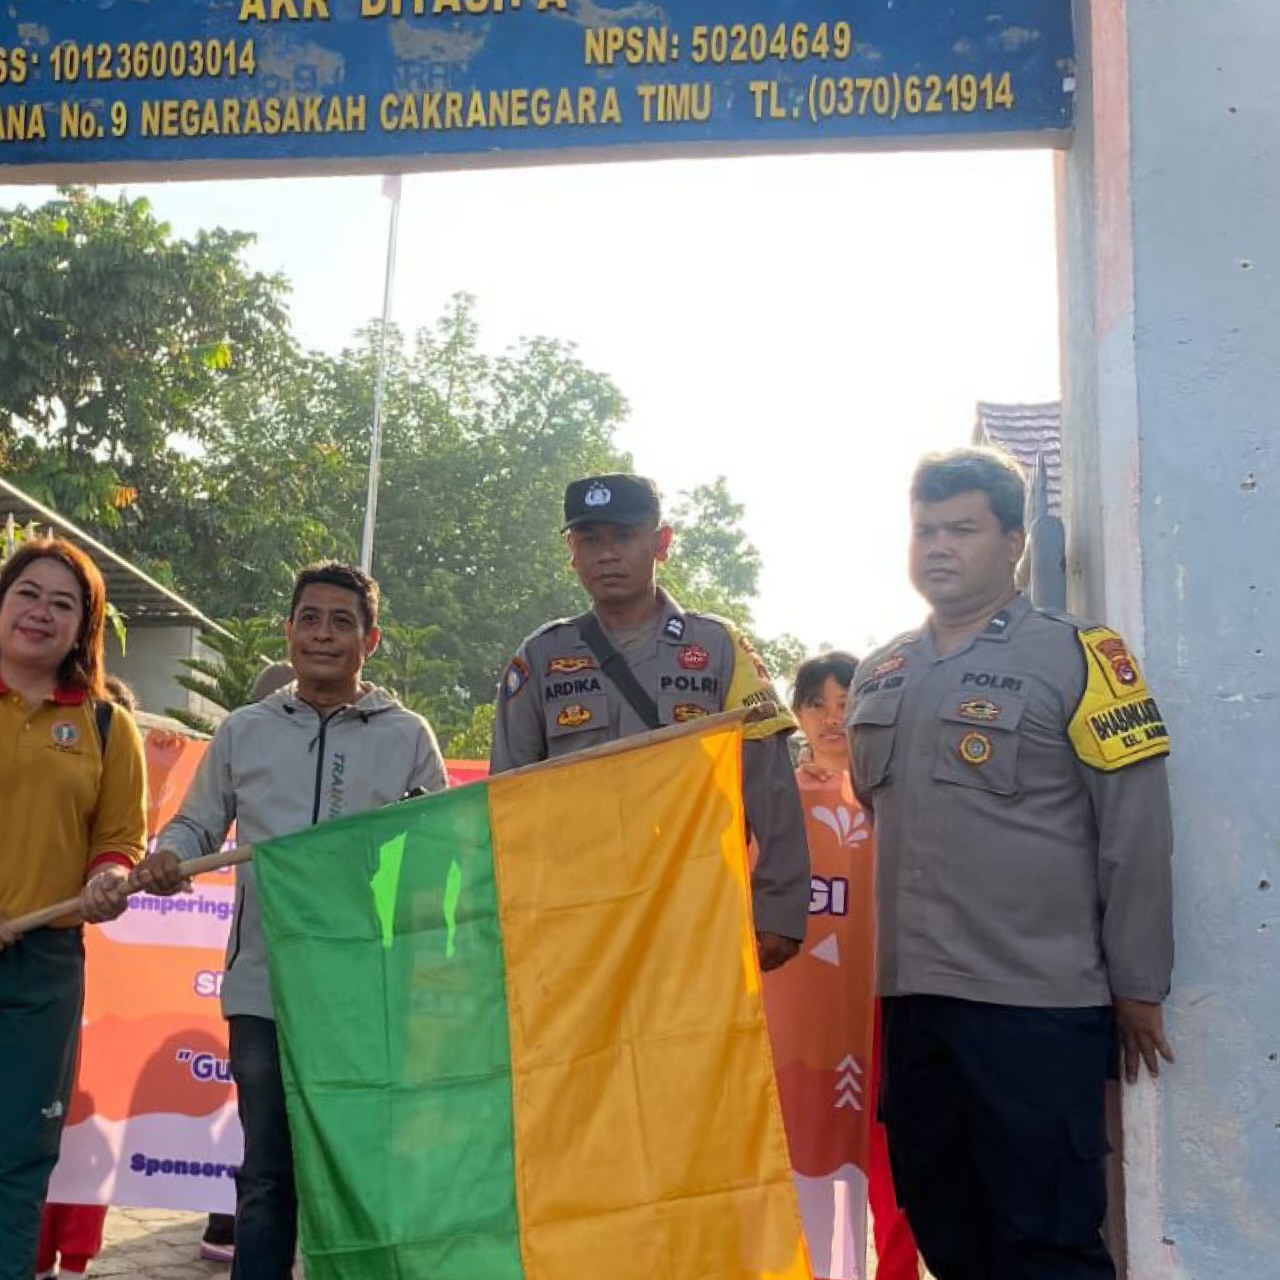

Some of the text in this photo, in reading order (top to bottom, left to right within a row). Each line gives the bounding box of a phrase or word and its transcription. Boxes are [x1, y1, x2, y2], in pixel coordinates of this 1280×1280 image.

[584, 21, 852, 65] NPSN: 50204649
[50, 39, 256, 81] 101236003014
[141, 94, 366, 137] NEGARASAKAH
[380, 86, 622, 131] CAKRANEGARA
[637, 82, 712, 123] TIMU
[808, 72, 1014, 123] (0370)621914
[545, 677, 602, 702] ARDIKA
[660, 675, 719, 695] POLRI
[960, 672, 1024, 692] POLRI
